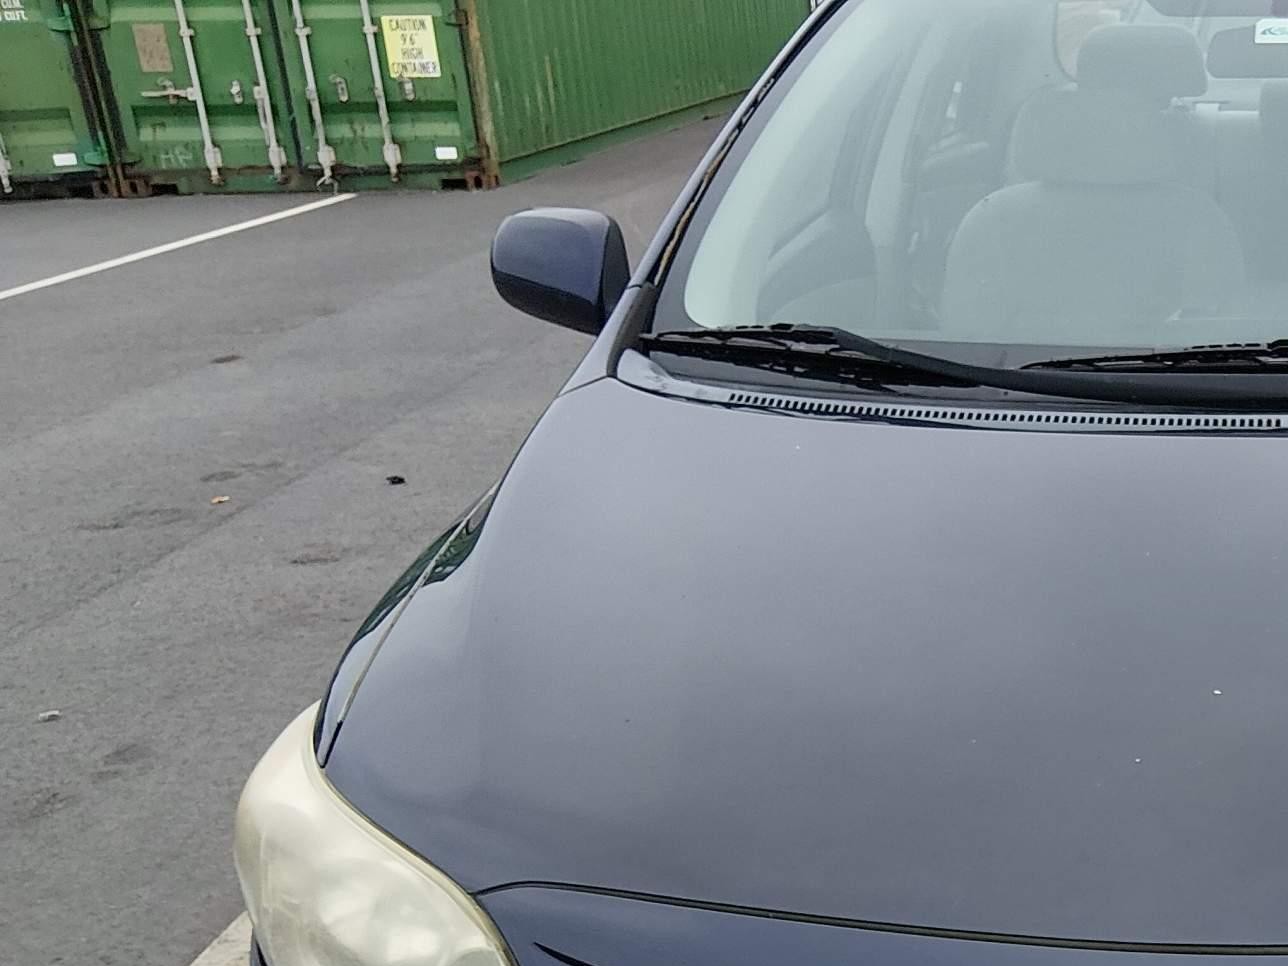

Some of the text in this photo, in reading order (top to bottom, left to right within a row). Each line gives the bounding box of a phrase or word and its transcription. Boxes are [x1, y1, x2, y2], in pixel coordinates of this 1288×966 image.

[389, 18, 427, 31] CAUTION
[401, 47, 425, 60] HIGH
[391, 61, 437, 74] CONTAINER
